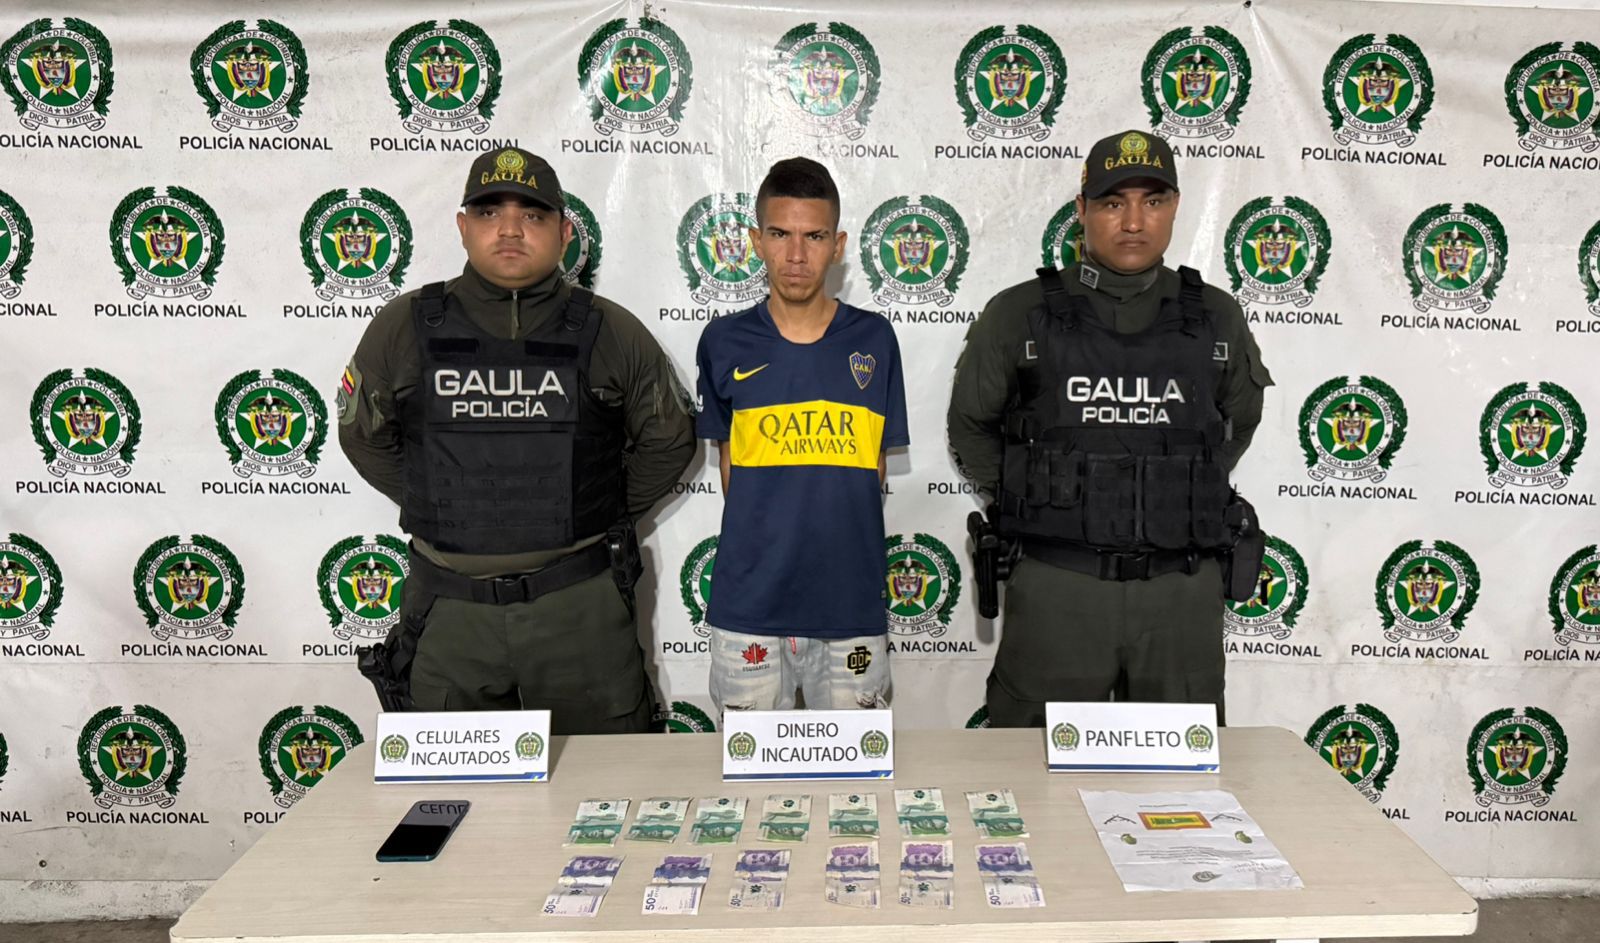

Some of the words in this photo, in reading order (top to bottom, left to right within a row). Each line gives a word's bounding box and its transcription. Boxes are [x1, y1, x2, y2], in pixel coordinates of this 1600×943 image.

[58, 136, 142, 148] NACIONAL
[180, 134, 244, 149] POLICÍA
[249, 137, 332, 150] NACIONAL
[371, 135, 436, 151] POLICÍA
[562, 138, 624, 152] POLICÍA
[628, 141, 713, 154] NACIONAL
[936, 143, 996, 158] POLICÍA
[1002, 146, 1082, 158] NACIONAL
[1187, 145, 1264, 158] NACIONAL
[1302, 145, 1361, 161] POLICÍA
[1366, 150, 1447, 166] NACIONAL
[1105, 155, 1163, 170] GAULA
[1484, 153, 1545, 169] POLICÍA
[481, 171, 538, 189] GAULA
[95, 304, 158, 316] POLICÍA
[164, 305, 246, 317] NACIONAL
[284, 305, 347, 317] POLICÍA
[660, 308, 720, 321] POLICÍA
[1265, 312, 1342, 324] NACIONAL
[1381, 313, 1440, 328] POLICÍA
[1445, 318, 1520, 331] NACIONAL
[435, 369, 565, 396] GAULA
[1066, 376, 1185, 403] GAULA
[452, 396, 548, 418] POLICÍA
[1082, 403, 1171, 424] POLICÍA
[758, 411, 855, 444] QATAR
[780, 438, 857, 455] AIRWAYS
[16, 479, 79, 493] POLICÍA
[84, 482, 165, 493] NACIONAL
[202, 478, 265, 494] POLICÍA
[269, 482, 350, 494] NACIONAL
[1279, 485, 1335, 497] POLICÍA
[1341, 487, 1416, 499] NACIONAL
[1455, 491, 1515, 504] POLICÍA
[1520, 493, 1596, 505] NACIONAL
[3, 645, 84, 656] NACIONAL
[122, 642, 182, 656] POLICÍA
[186, 645, 267, 656] NACIONAL
[901, 641, 977, 652] NACIONAL
[1243, 644, 1322, 657] NACIONAL
[1352, 642, 1411, 658] POLICÍA
[1416, 645, 1489, 659] NACIONAL
[1524, 646, 1581, 661] POLICÍA
[416, 730, 500, 745] CELULARES
[777, 722, 839, 738] DINERO
[1086, 730, 1181, 747] PANFLETO
[411, 751, 510, 766] INCAUTADOS
[762, 747, 858, 762] INCAUTADO
[67, 808, 126, 822] POLICÍA
[130, 811, 209, 822] NACIONAL
[1445, 808, 1501, 822] POLICÍA
[1505, 810, 1578, 822] NACIONAL
[645, 897, 657, 910] 50
